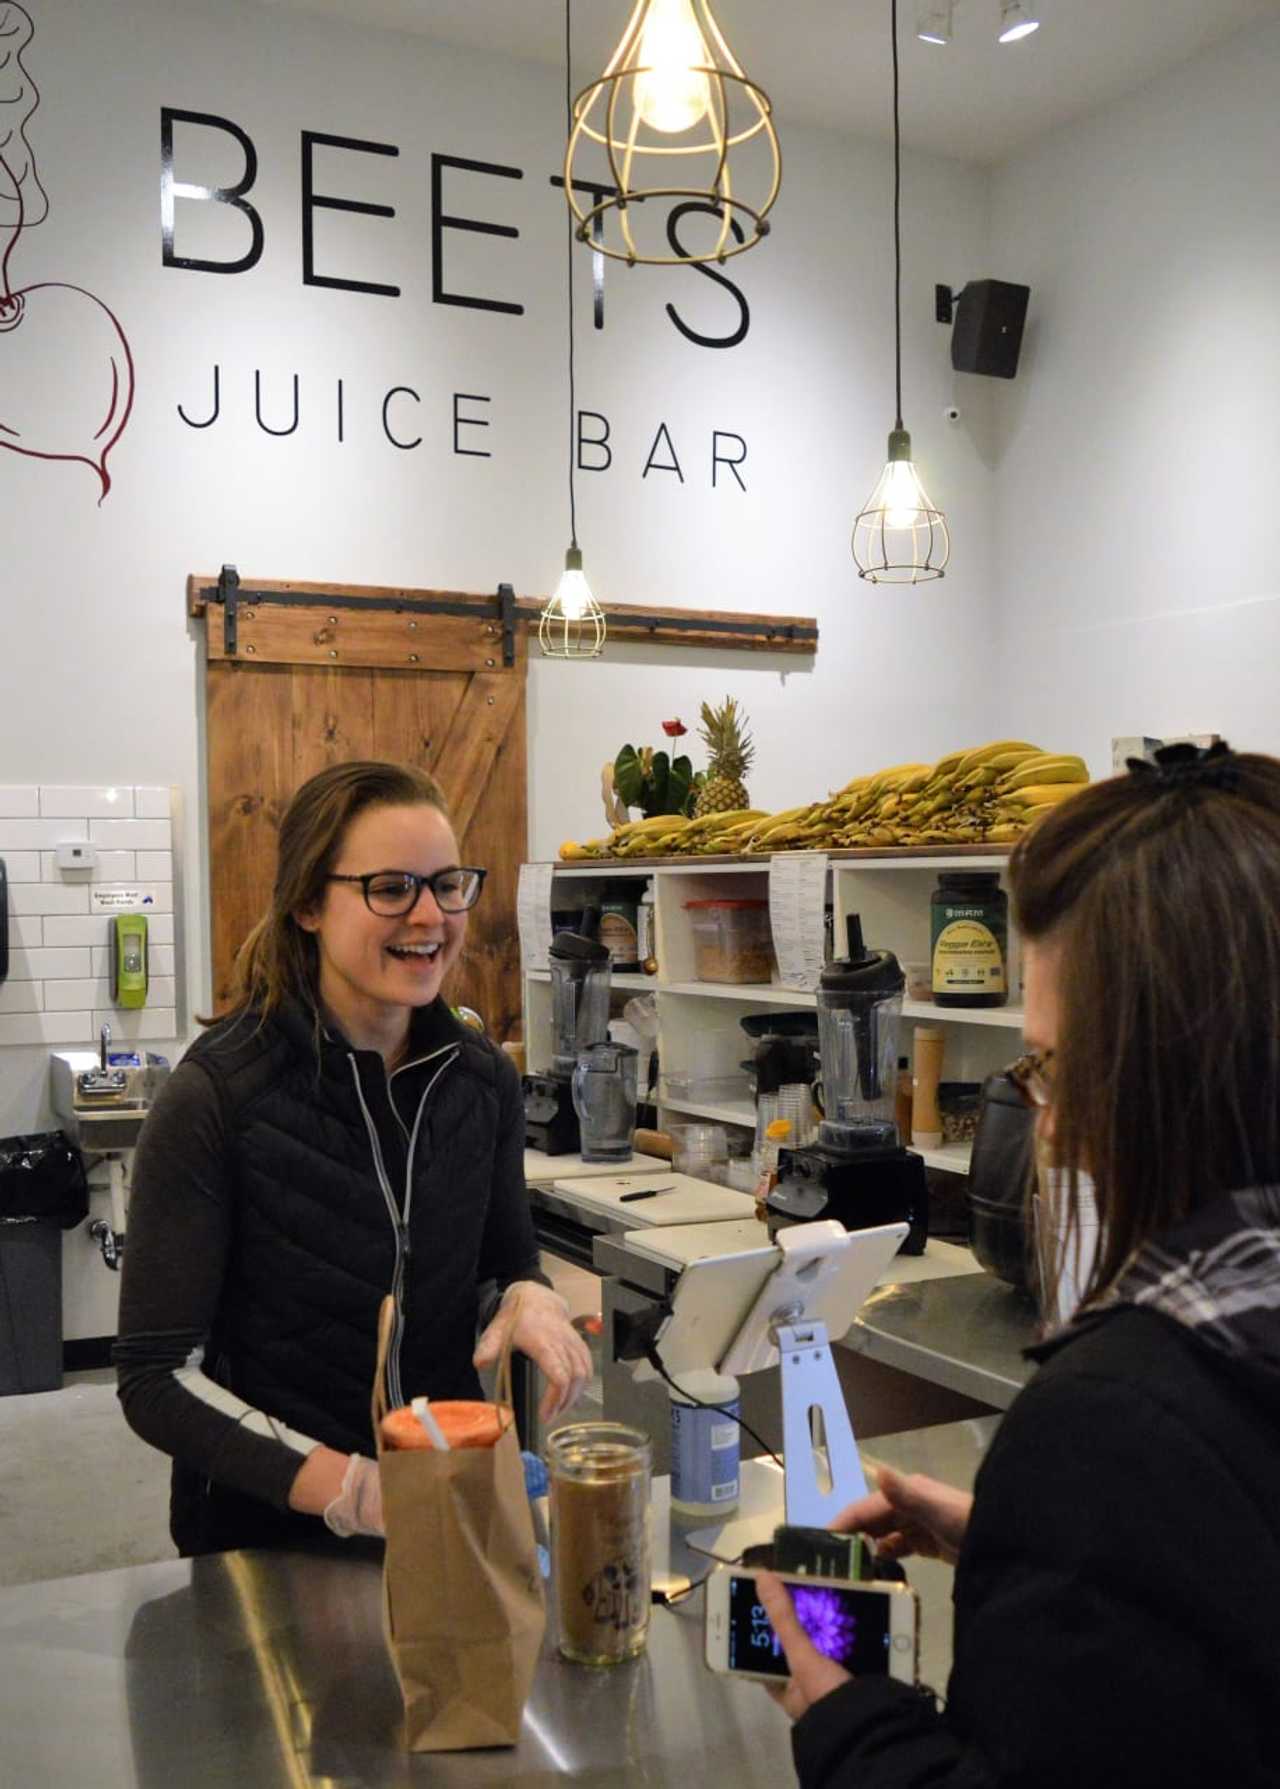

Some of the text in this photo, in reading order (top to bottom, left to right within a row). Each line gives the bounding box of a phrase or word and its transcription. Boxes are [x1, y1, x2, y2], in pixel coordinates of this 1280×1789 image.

[161, 106, 750, 349] BEETS
[178, 365, 748, 492] JUICE BAR
